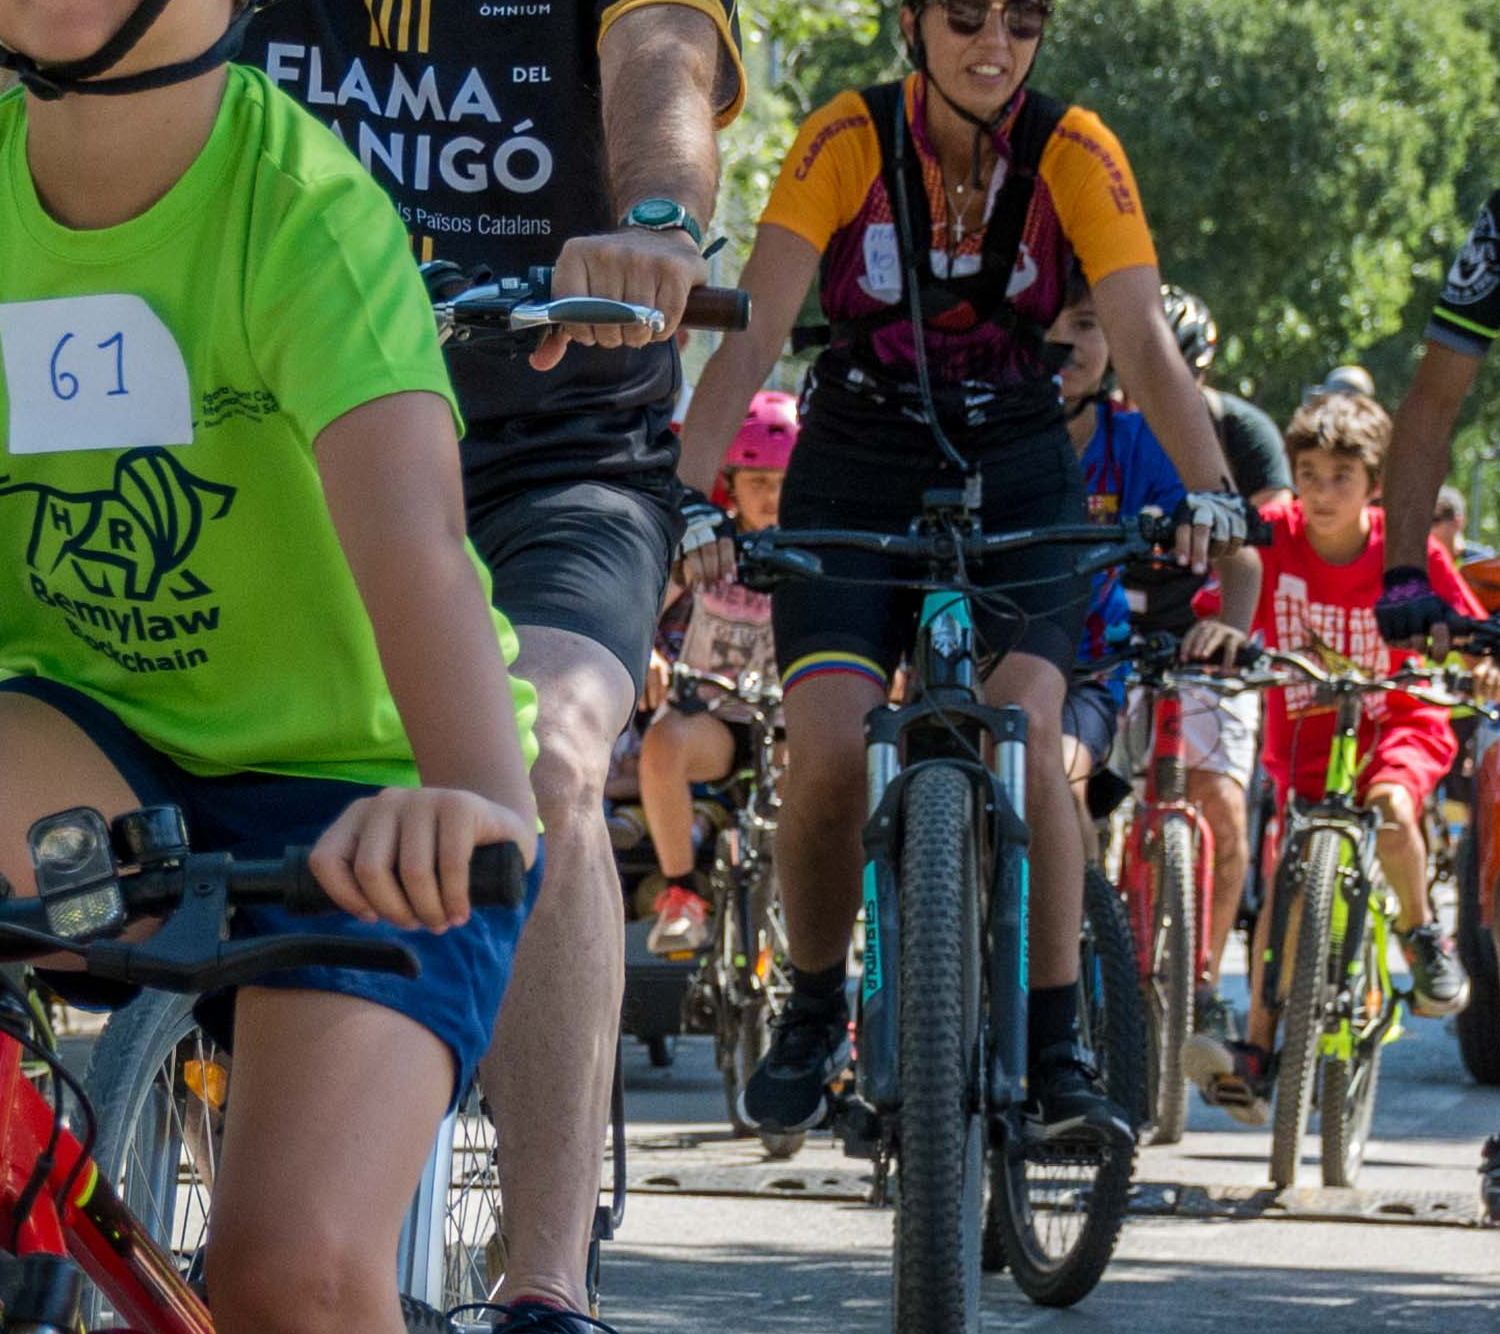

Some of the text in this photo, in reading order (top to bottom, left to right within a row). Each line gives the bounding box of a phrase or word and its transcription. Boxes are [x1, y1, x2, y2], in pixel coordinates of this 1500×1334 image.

[266, 42, 551, 123] FLAMA DEL
[331, 118, 553, 194] NIGÓ
[416, 208, 472, 233] Països
[478, 213, 551, 235] Catalans
[50, 331, 129, 400] 61
[51, 501, 73, 536] H
[108, 517, 136, 553] R
[30, 572, 220, 644] Bemylaw
